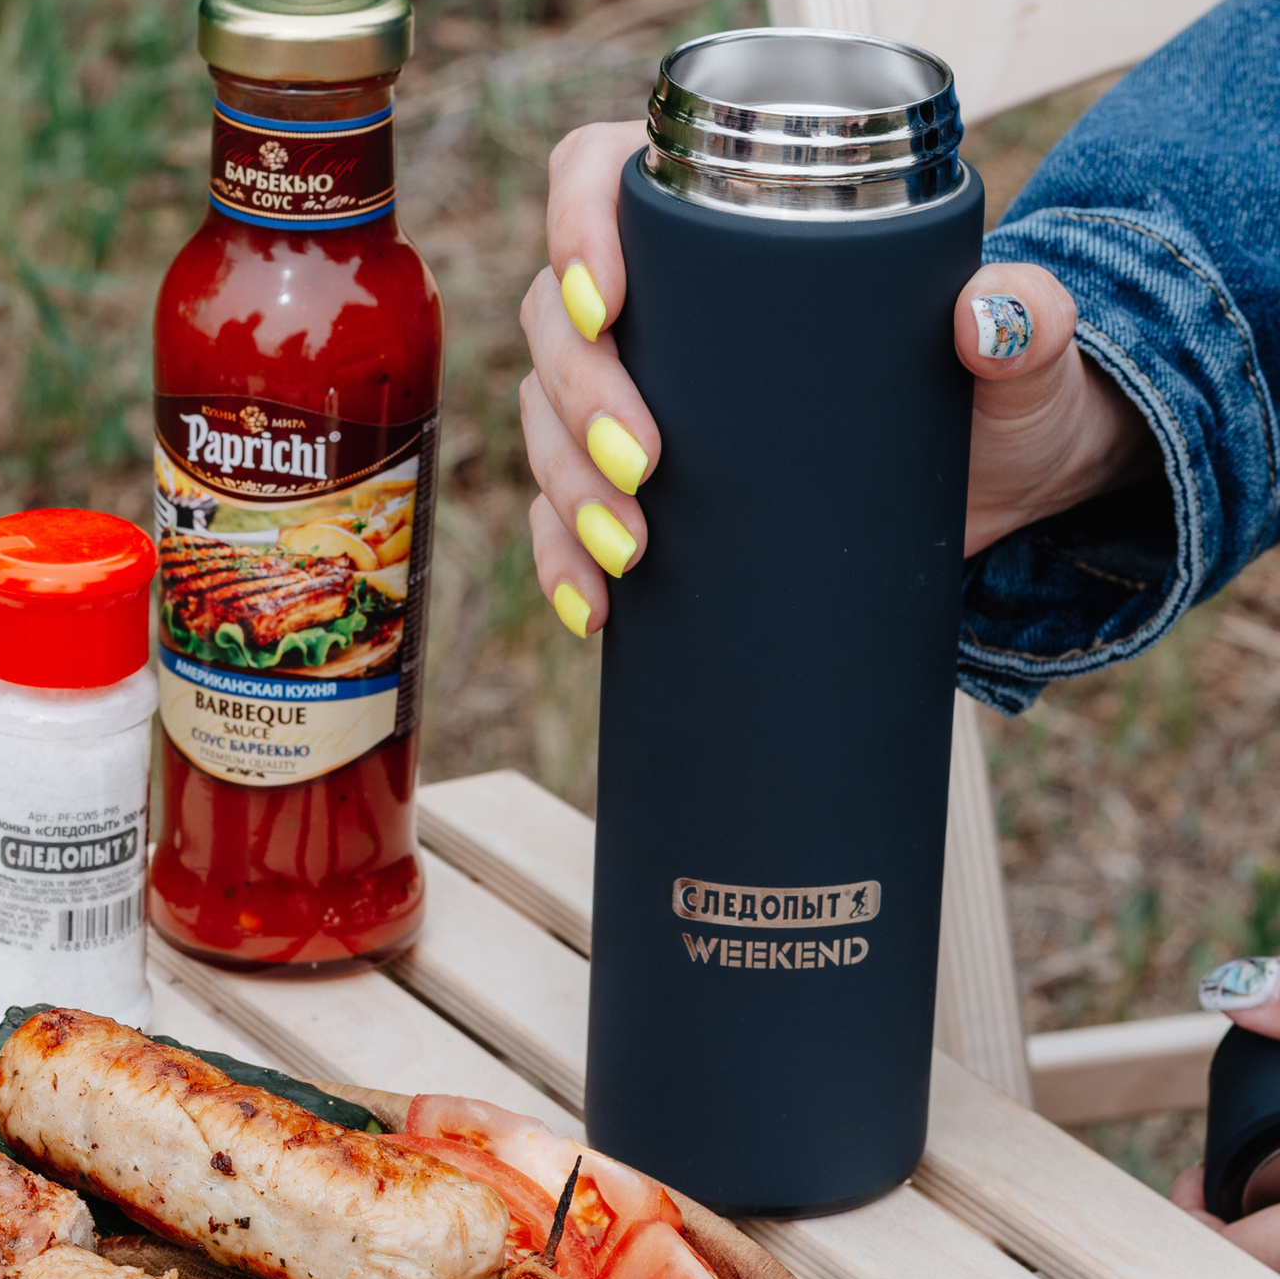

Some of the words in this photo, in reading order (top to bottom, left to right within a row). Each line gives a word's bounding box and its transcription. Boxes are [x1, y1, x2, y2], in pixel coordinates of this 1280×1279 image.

[224, 160, 334, 194] БАРБЕКЬЮ
[252, 190, 293, 210] СОУС
[201, 405, 236, 422] КУХНИ
[271, 418, 307, 429] МИРА
[179, 413, 328, 480] Paprichi
[175, 659, 283, 697] АМЕРИКАНСКАЯ
[285, 682, 337, 698] КУХНЯ
[194, 690, 307, 727] BARBEQUE
[191, 727, 226, 749] СОУС
[229, 739, 310, 758] БАРБЕКЬЮ
[223, 722, 270, 740] SAUCE
[199, 746, 246, 765] PREMIUM
[249, 758, 297, 771] QUALITY
[35, 818, 120, 838] «СЛЕДОПЫТ»
[4, 838, 122, 872] СЛЕДОПЫТ
[680, 886, 841, 921] СЛЕДОПЫТ
[681, 933, 869, 969] WEEKEND
